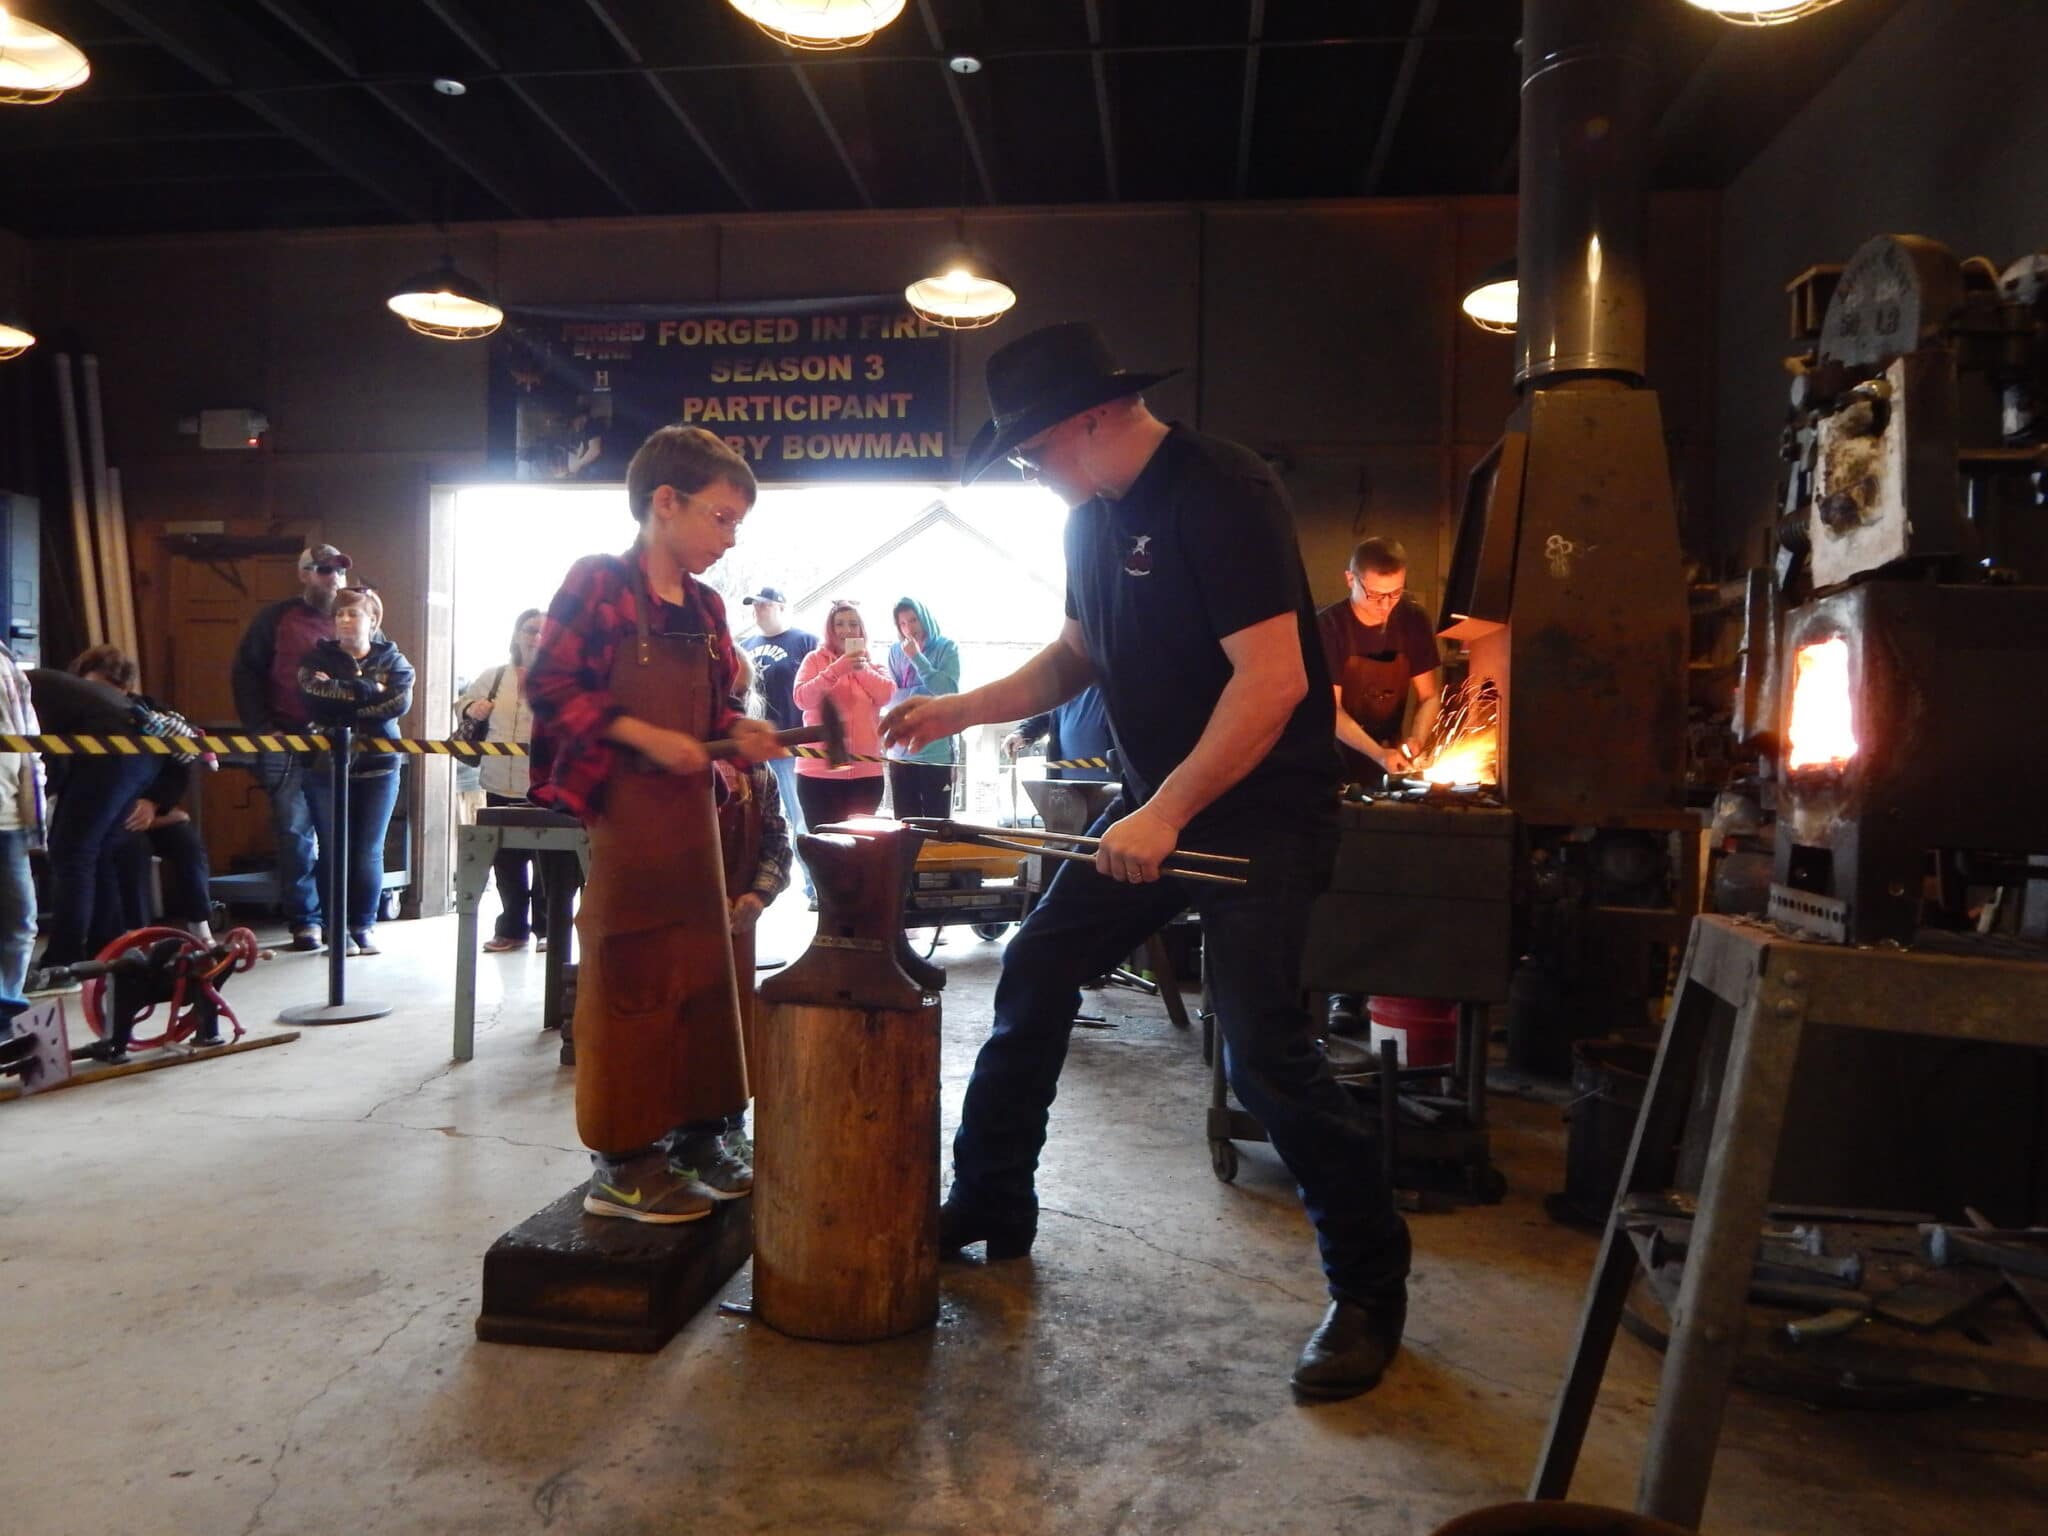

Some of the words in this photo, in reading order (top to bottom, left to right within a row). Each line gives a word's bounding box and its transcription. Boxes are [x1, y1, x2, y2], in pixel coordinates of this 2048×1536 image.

[658, 318, 799, 346] FORGED
[811, 316, 848, 341] IN
[859, 314, 940, 339] FIRE
[711, 354, 852, 383] SEASON
[864, 354, 885, 381] 3
[683, 393, 913, 422] PARTICIPANT
[782, 432, 944, 460] BOWMAN
